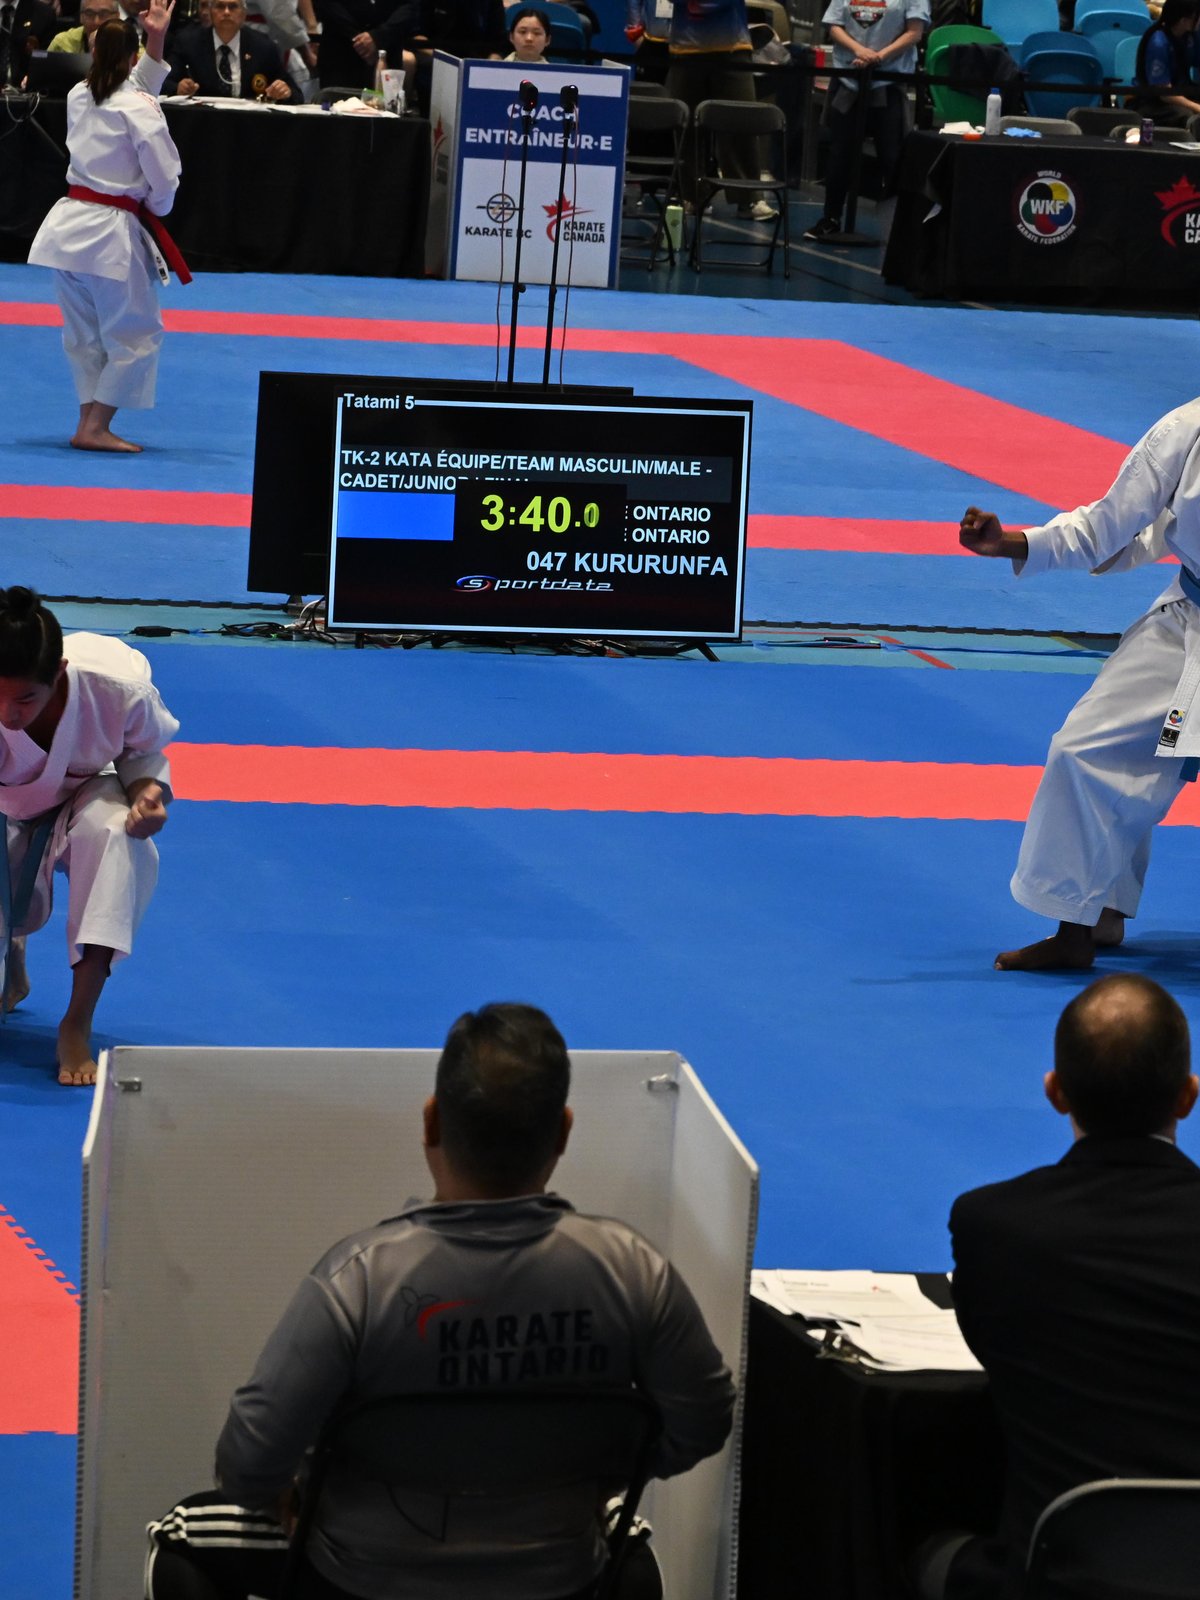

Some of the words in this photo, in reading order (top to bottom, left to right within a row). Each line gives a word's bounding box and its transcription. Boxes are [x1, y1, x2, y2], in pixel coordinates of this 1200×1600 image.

[1030, 199, 1065, 215] WKF
[465, 226, 513, 238] KARATE
[564, 220, 605, 233] KARATE
[563, 231, 605, 243] CANADA
[343, 393, 400, 409] Tatami
[405, 395, 415, 410] 5
[341, 449, 380, 466] TK-2
[385, 451, 432, 467] KATA
[437, 450, 554, 472] ÉQUIPE/TEAM
[559, 457, 701, 476] MASCULIN/MALE
[340, 472, 469, 490] CADET/JUNIO
[480, 494, 600, 534] 3:40.0
[632, 505, 711, 523] ONTARIO
[632, 527, 710, 545] ONTARIO
[526, 551, 567, 571] 047
[574, 552, 729, 576] KURURUNFA
[439, 1309, 593, 1353] KARATE
[438, 1344, 609, 1387] ONTARIO
